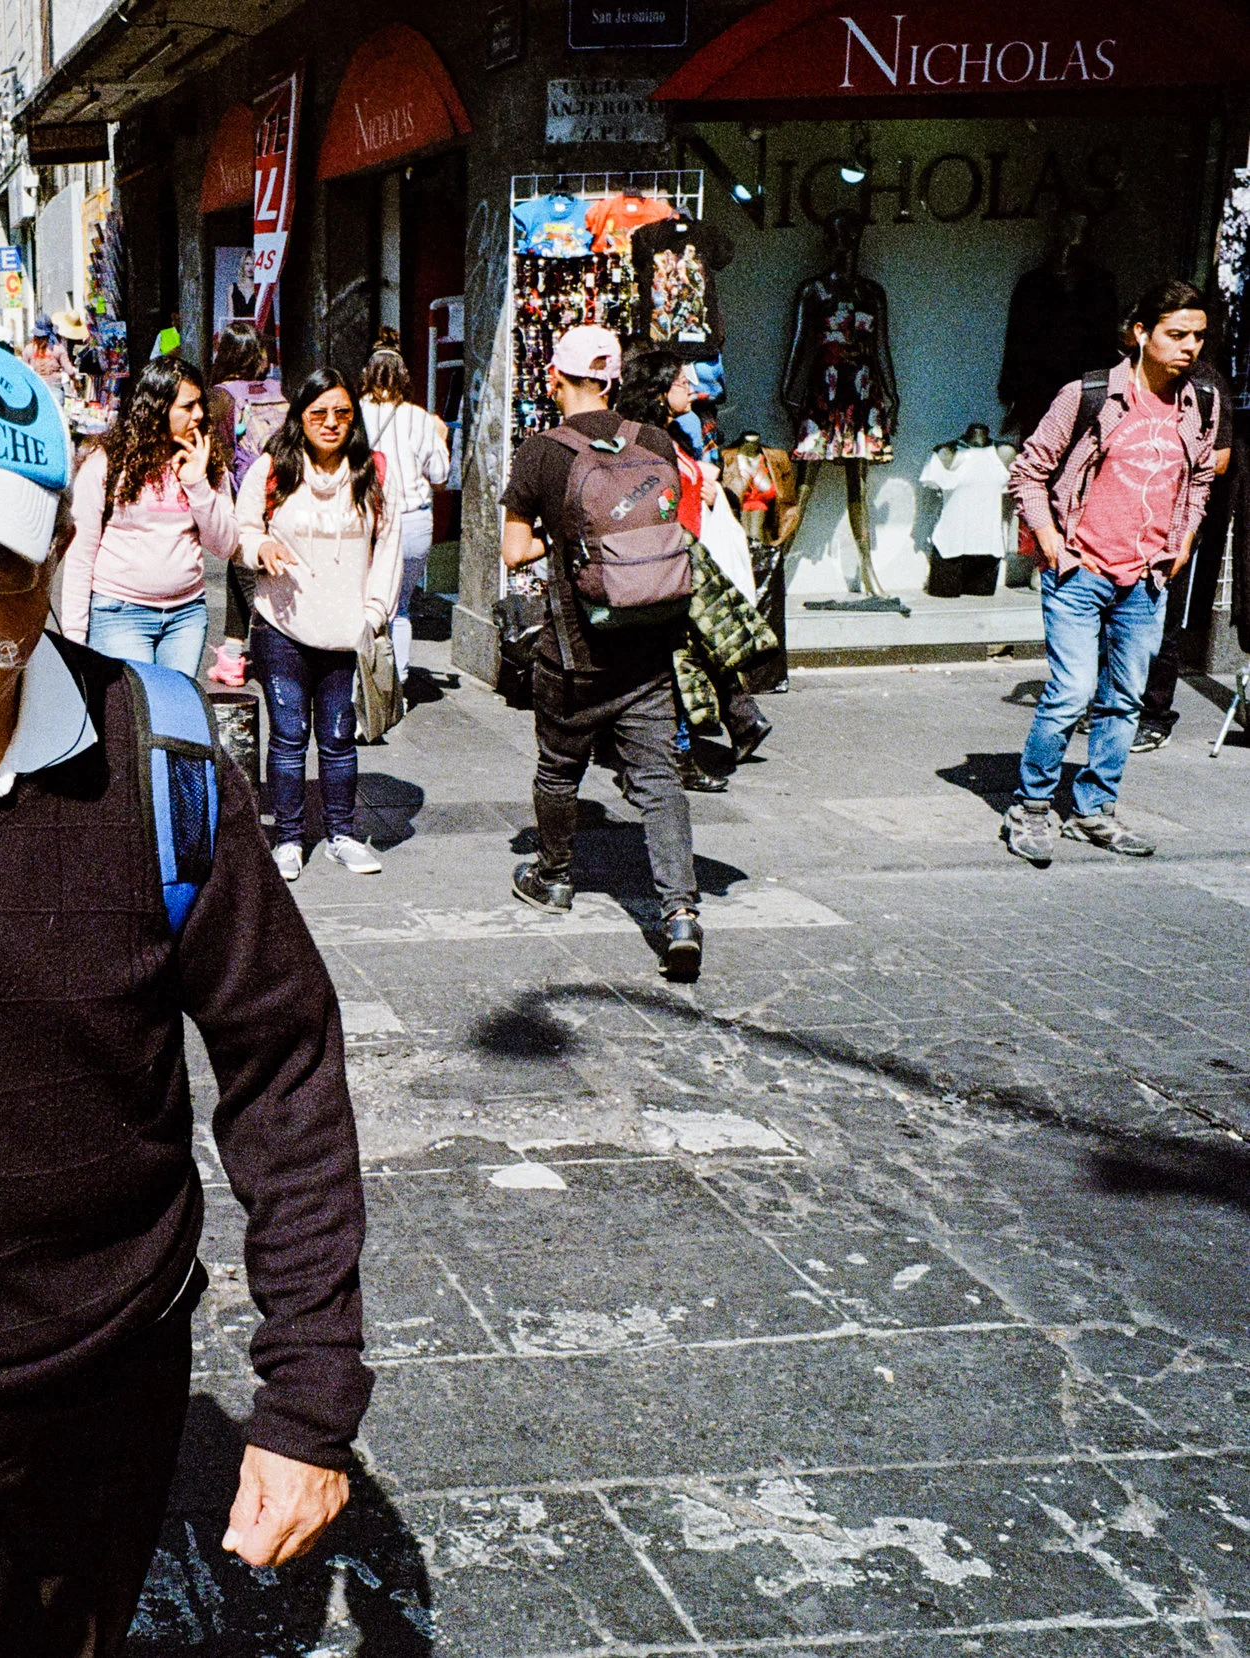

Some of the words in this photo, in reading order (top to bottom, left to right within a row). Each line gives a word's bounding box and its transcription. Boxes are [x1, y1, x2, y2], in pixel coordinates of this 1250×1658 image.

[591, 7, 612, 24] San
[838, 13, 1117, 89] NICHOLAS
[609, 475, 661, 521] adidas
